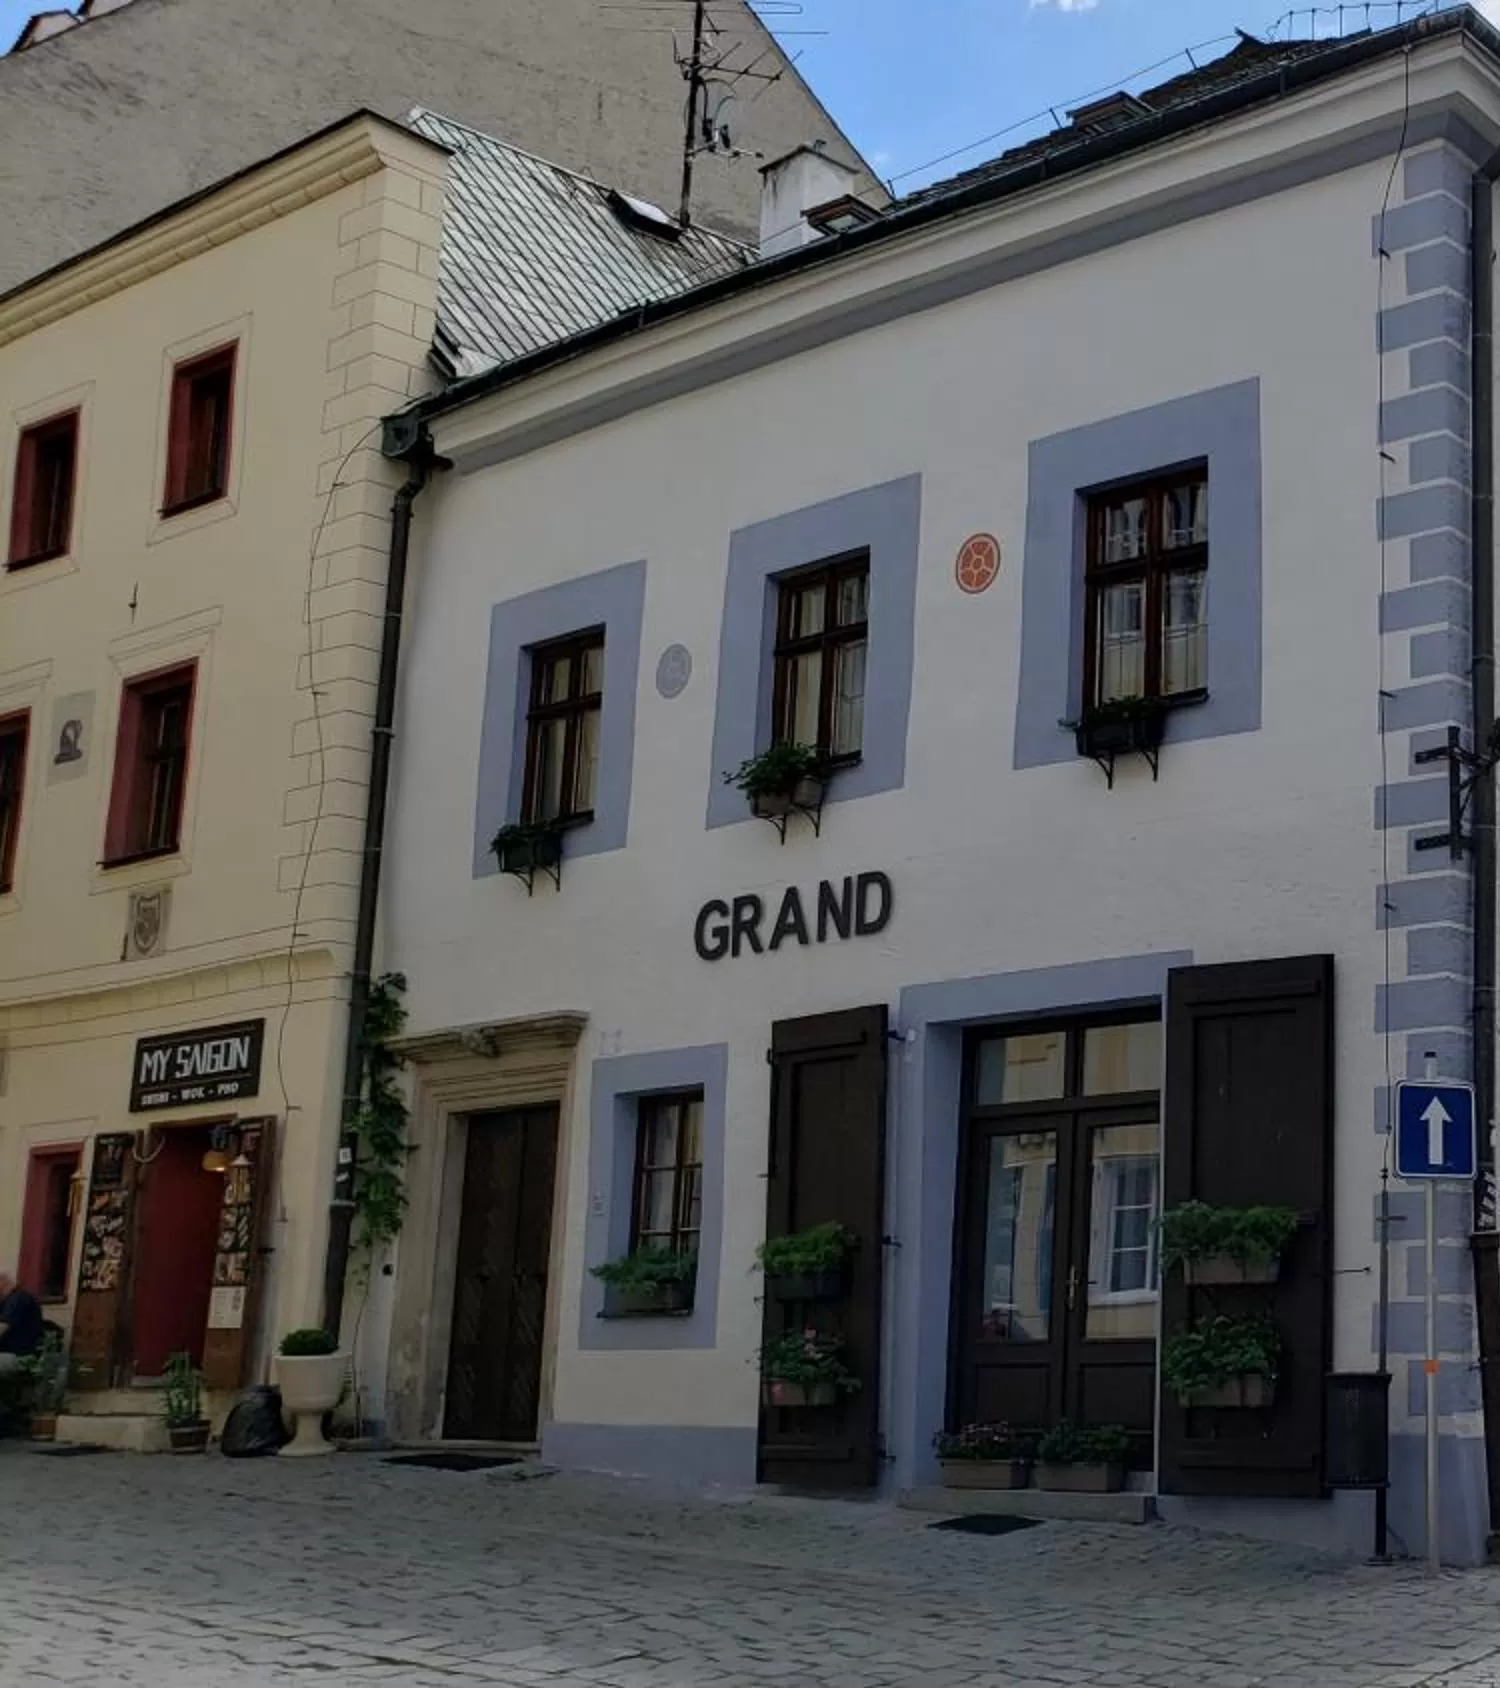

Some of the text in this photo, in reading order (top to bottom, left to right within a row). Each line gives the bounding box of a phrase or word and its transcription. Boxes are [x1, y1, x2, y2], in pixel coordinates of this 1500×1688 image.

[694, 870, 893, 961] GRAND
[140, 1035, 251, 1084] MY SAIGON
